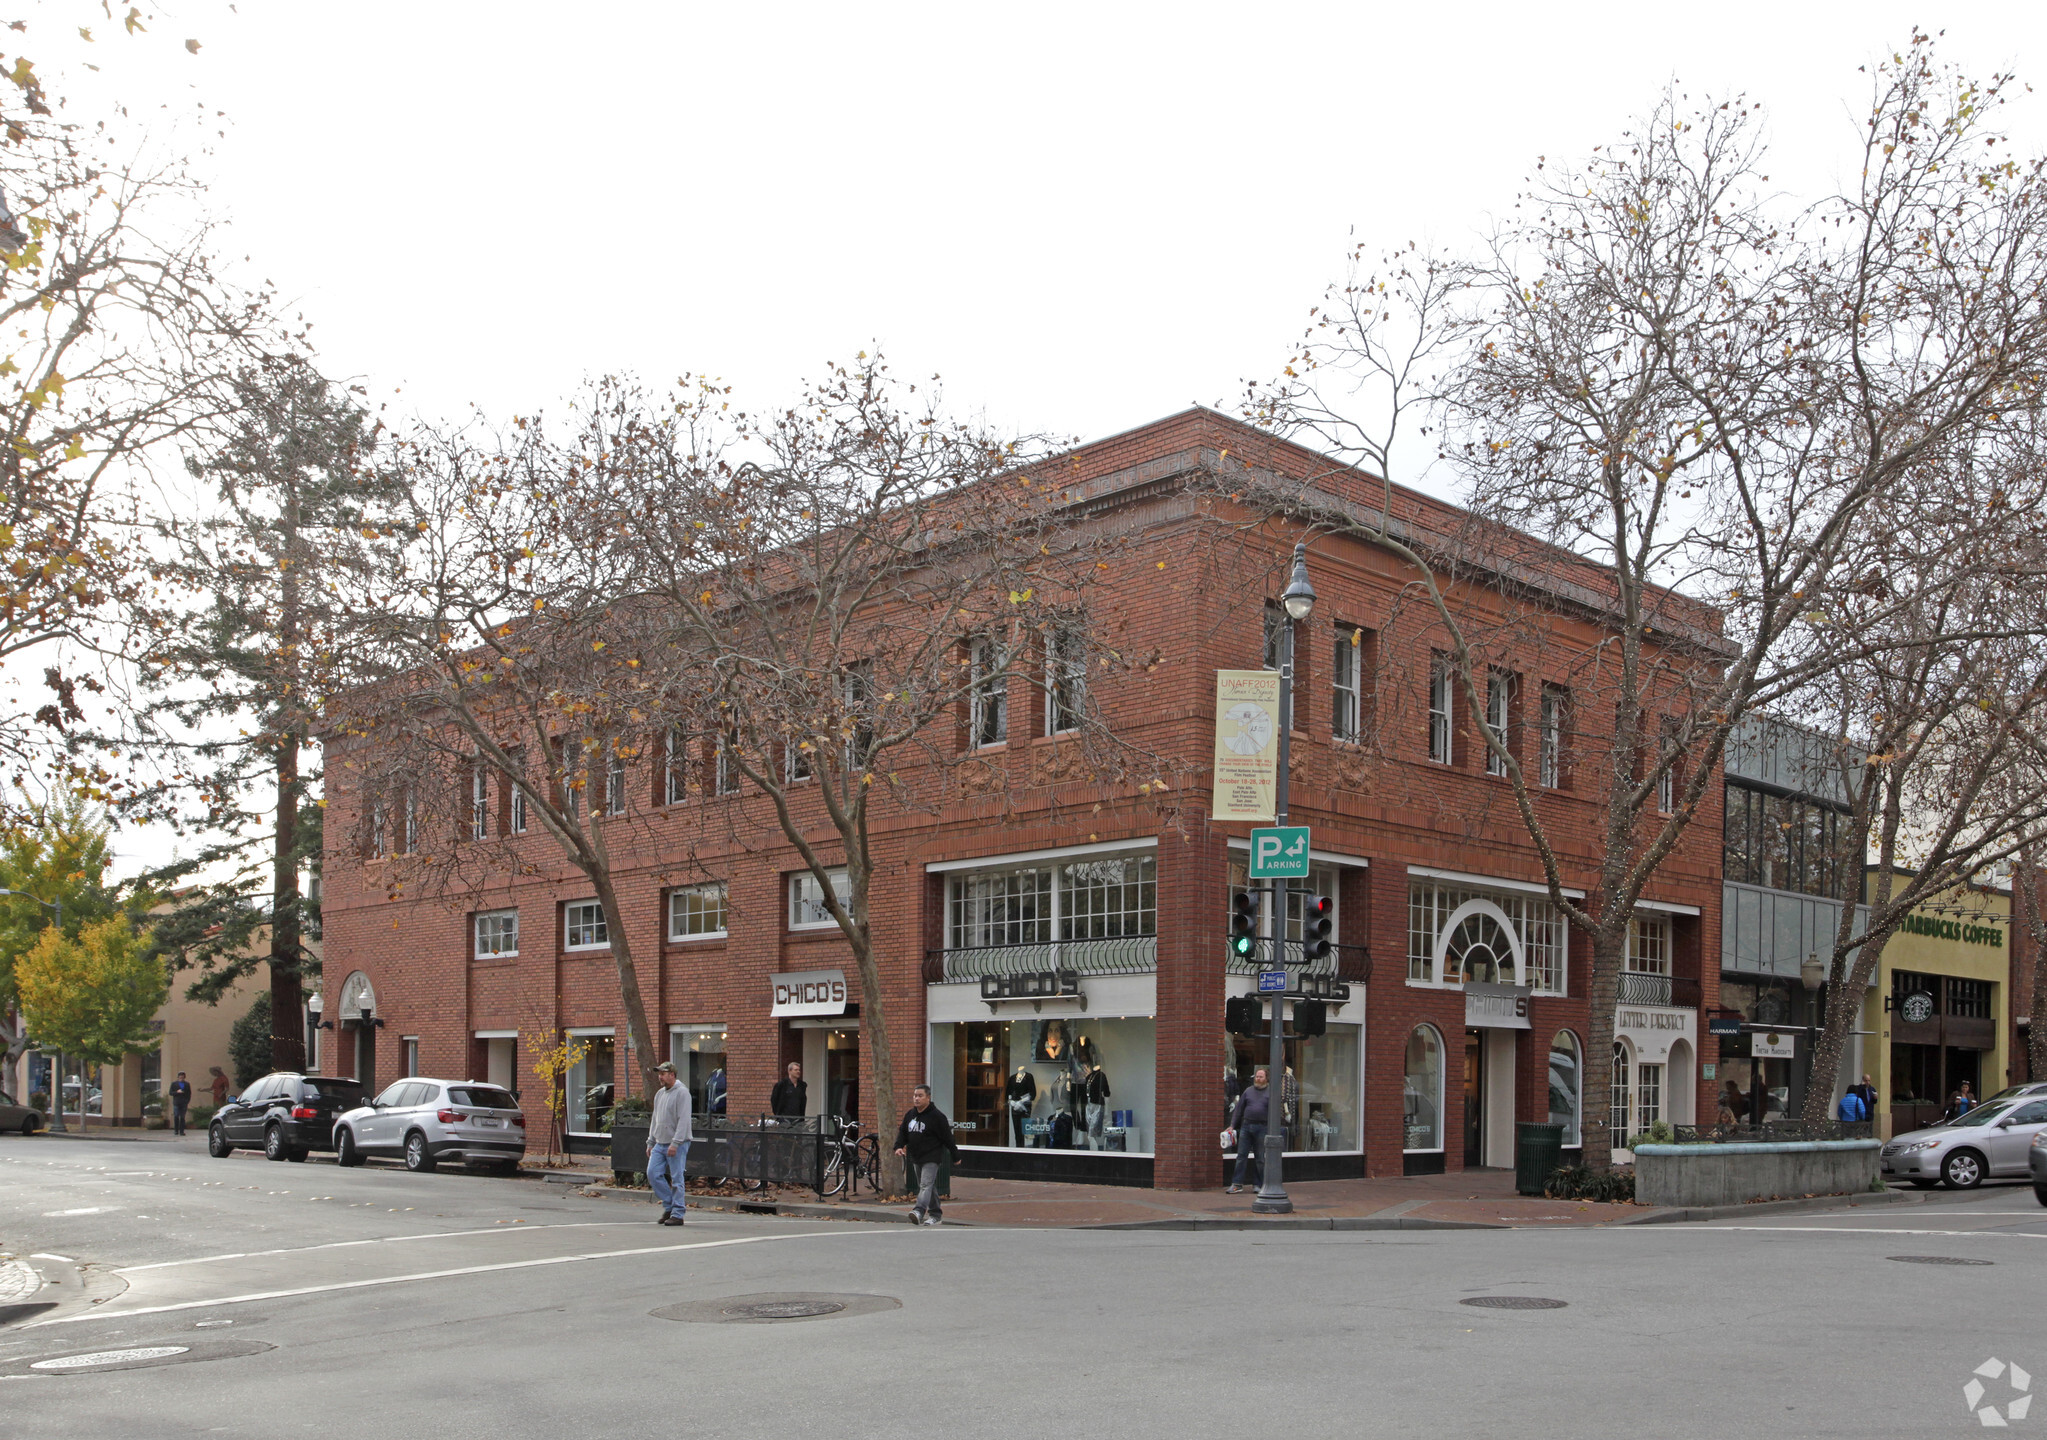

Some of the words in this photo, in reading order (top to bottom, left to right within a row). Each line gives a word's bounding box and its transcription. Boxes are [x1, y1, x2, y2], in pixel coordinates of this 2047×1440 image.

[1221, 679, 1276, 689] UNAFF2012
[1899, 914, 1961, 941] TARBUCKS
[1963, 923, 2003, 948] COFFEE
[776, 979, 845, 1005] CHICO'S
[981, 967, 1078, 999] CHICO'S
[1619, 1011, 1648, 1029] LETTER
[1650, 1013, 1686, 1031] PERFECT
[953, 1121, 977, 1130] CHICO'S
[1025, 1123, 1051, 1132] CHICO'S
